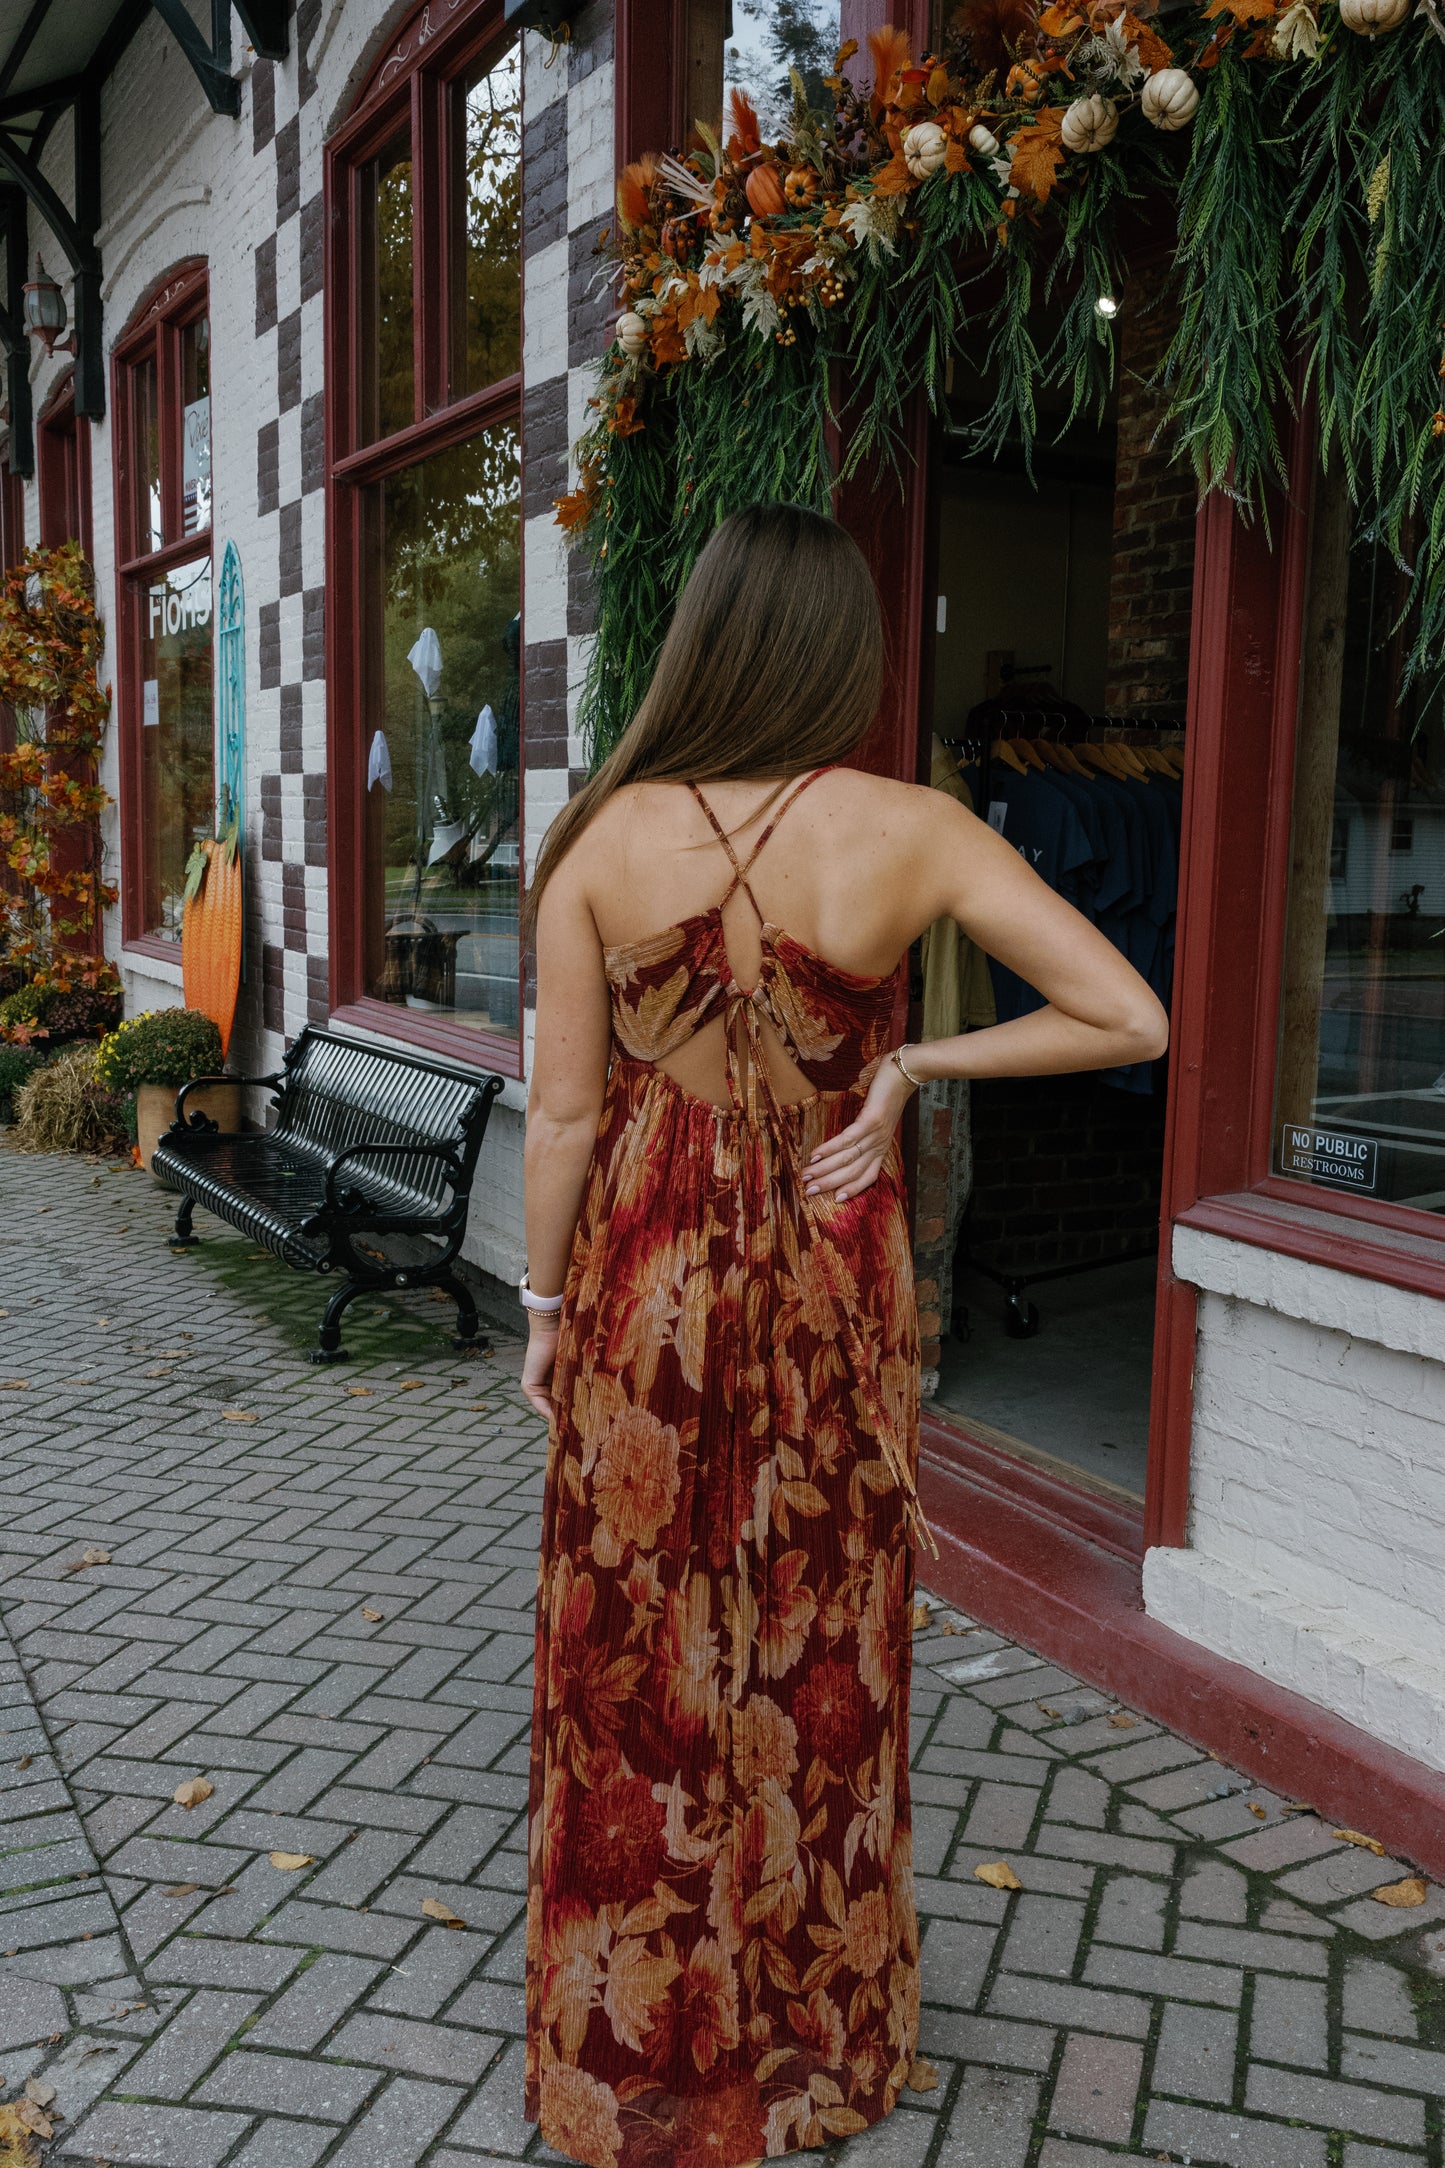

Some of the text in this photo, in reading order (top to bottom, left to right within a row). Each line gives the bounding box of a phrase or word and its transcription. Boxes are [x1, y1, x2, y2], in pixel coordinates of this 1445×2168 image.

[1292, 1131, 1368, 1160] NO PUBLIC
[1292, 1154, 1365, 1180] RESTROOMS
